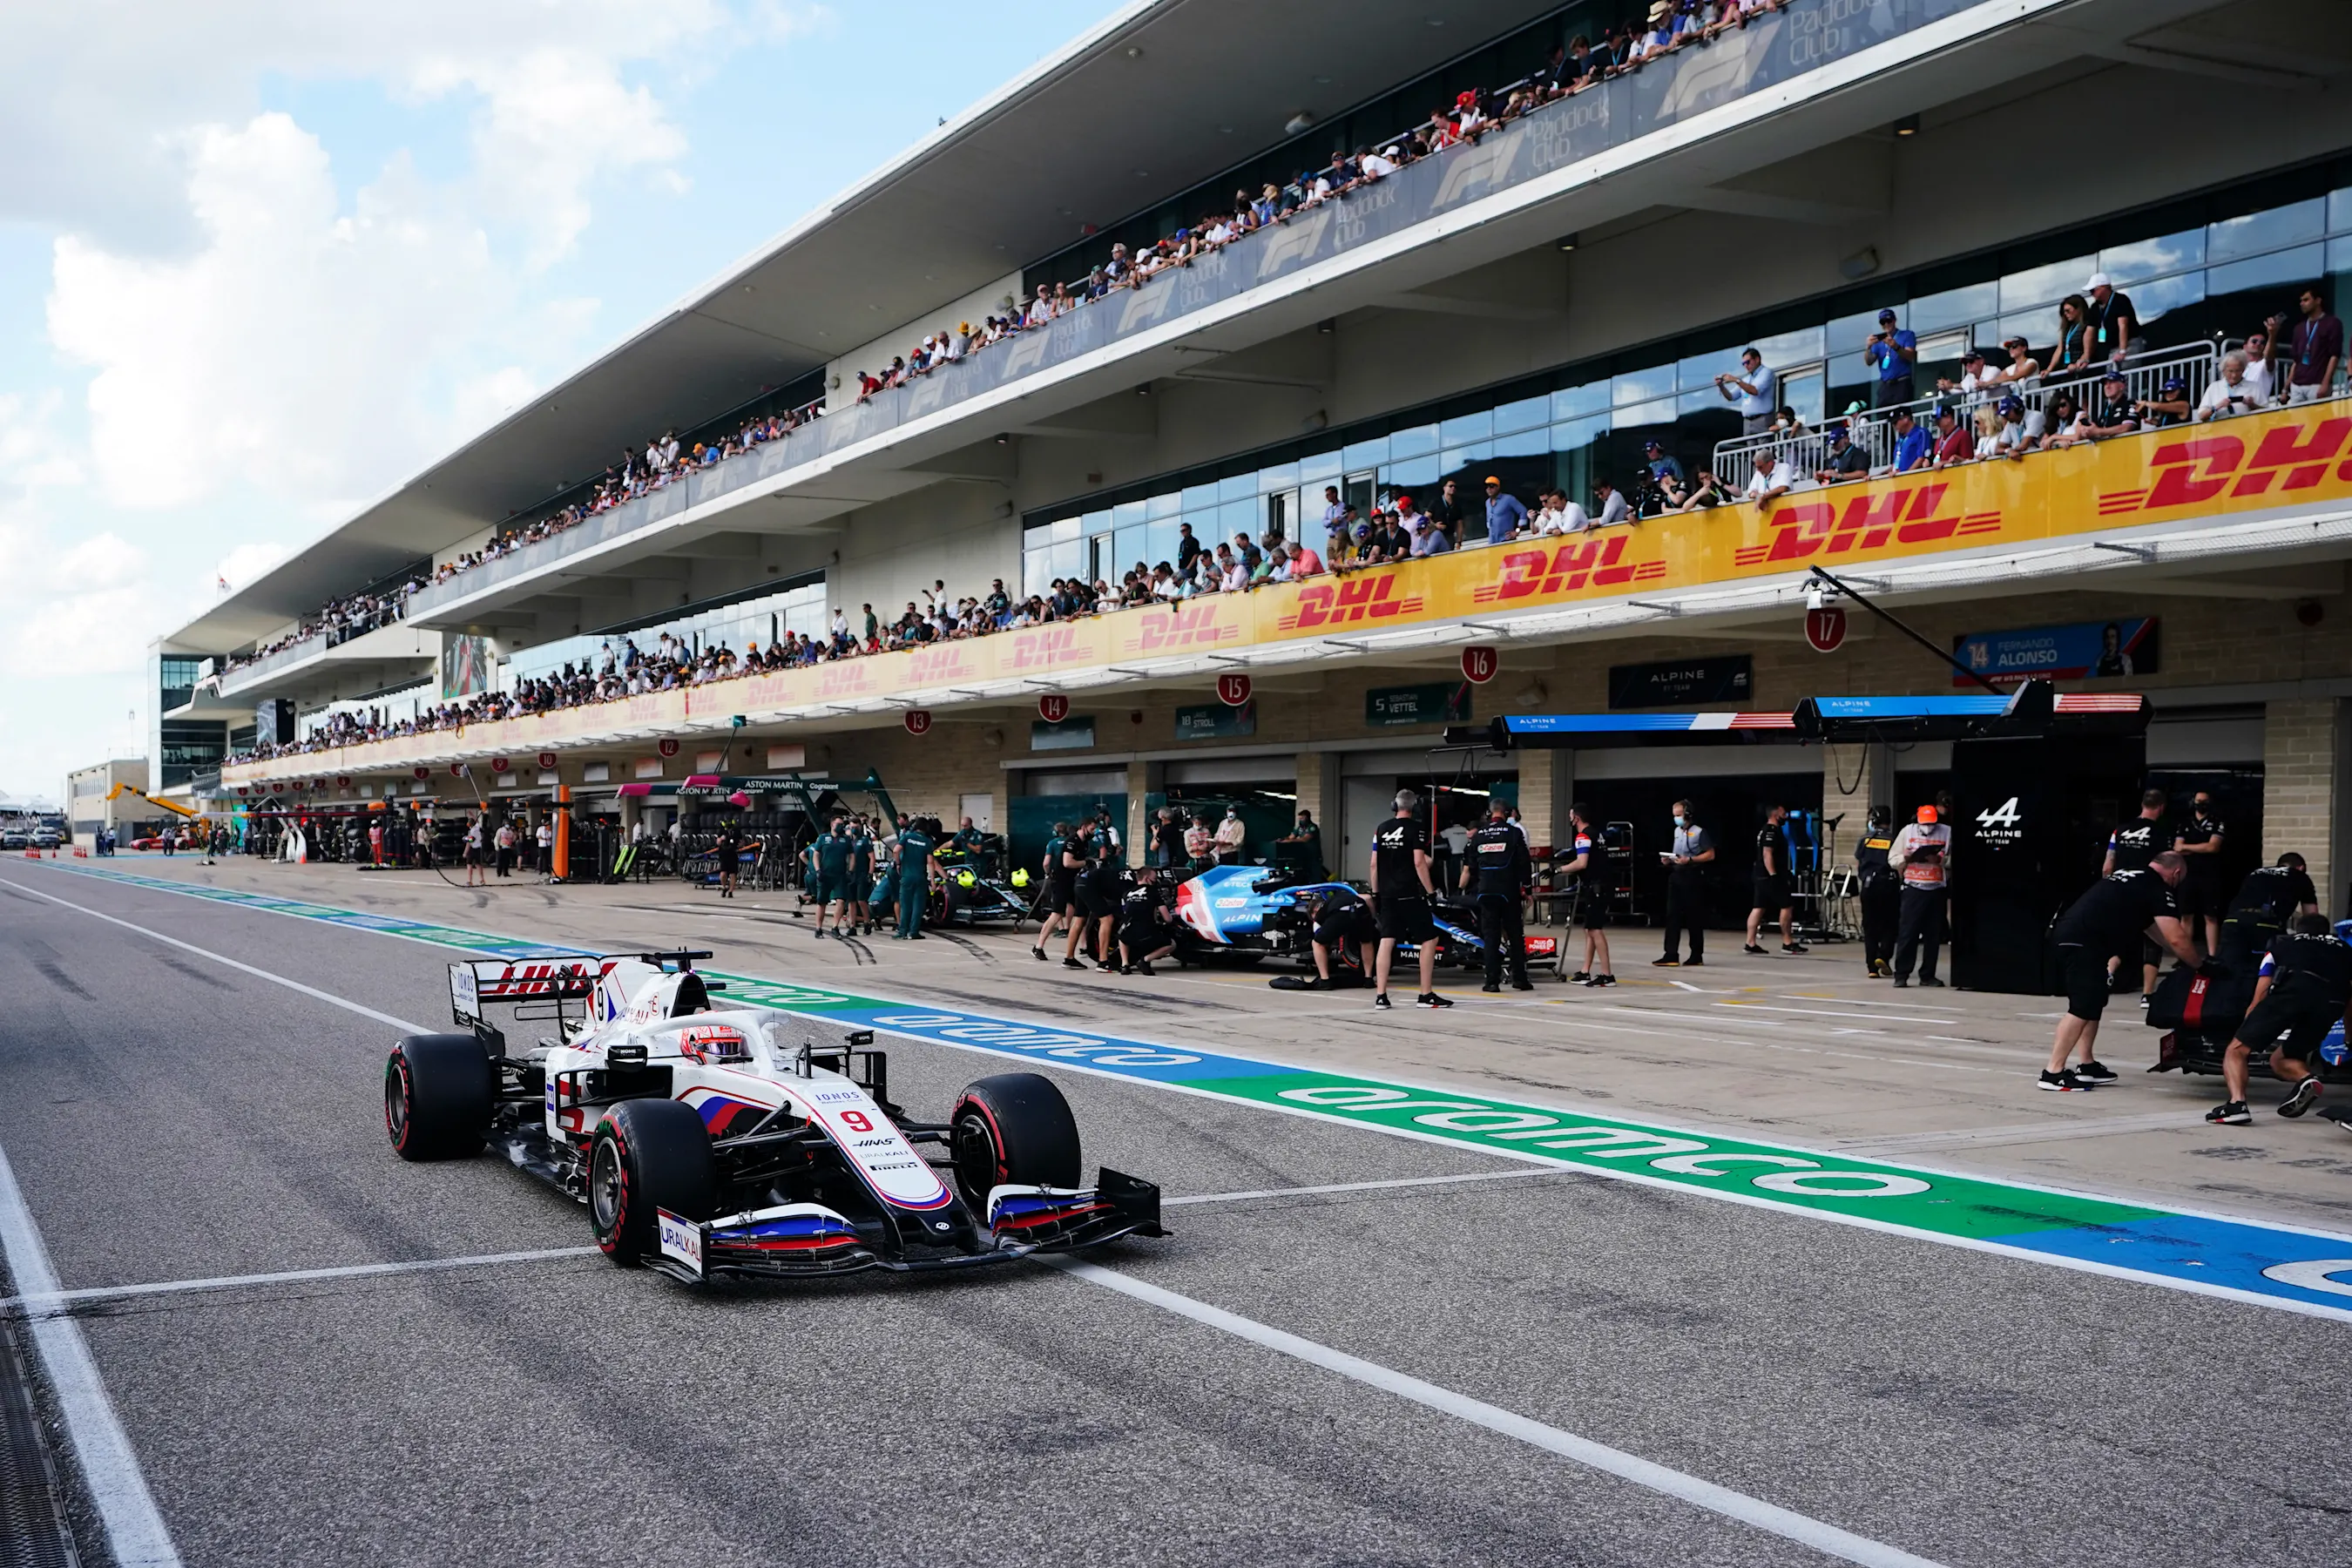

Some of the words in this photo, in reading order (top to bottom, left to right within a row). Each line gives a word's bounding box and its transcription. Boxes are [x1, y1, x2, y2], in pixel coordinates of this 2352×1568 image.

[1789, 27, 1841, 65] Club
[1532, 92, 1609, 145] Paddock
[1531, 137, 1571, 168] Club
[1335, 186, 1396, 224] Paddock
[1335, 218, 1366, 246] Club
[1767, 483, 1960, 562] DHL
[1498, 535, 1637, 599] DHL
[1296, 574, 1402, 627] DHL
[1139, 604, 1221, 650] DHL
[1820, 612, 1835, 641] 17
[1013, 628, 1080, 668] DHL
[1968, 642, 1990, 669] 14
[1997, 638, 2054, 652] FERNANDO
[1997, 649, 2058, 666] ALONSO
[909, 648, 965, 684] DHL
[1472, 651, 1488, 674] 16
[821, 665, 868, 697] DHL
[1651, 669, 1705, 683] ALPINE
[747, 678, 788, 706] DHL
[1228, 679, 1242, 697] 15
[1048, 700, 1060, 716] 14
[1375, 698, 1385, 711] 5
[1389, 701, 1418, 713] VETTEL
[914, 713, 924, 729] 13
[1193, 718, 1215, 728] STROLL
[665, 741, 674, 754] 12
[497, 759, 503, 768] 9
[543, 754, 552, 765] 10
[420, 769, 425, 778] 7
[745, 780, 772, 789] ASTON
[774, 781, 803, 790] MARTIN
[809, 782, 839, 791] Cognizant
[1975, 829, 2022, 838] ALPINE
[1484, 843, 1504, 852] Castrol
[457, 971, 475, 992] IONOS
[597, 986, 604, 1021] 9
[872, 1014, 1203, 1067] aramco
[815, 1092, 860, 1101] IONOS
[840, 1111, 874, 1132] 9
[852, 1138, 896, 1147] HAAS
[1276, 1085, 1931, 1199] aramco
[860, 1150, 909, 1159] URALKALI
[869, 1161, 918, 1172] PIRELLI
[612, 1166, 628, 1242] ZERO
[660, 1226, 701, 1263] URALKALI
